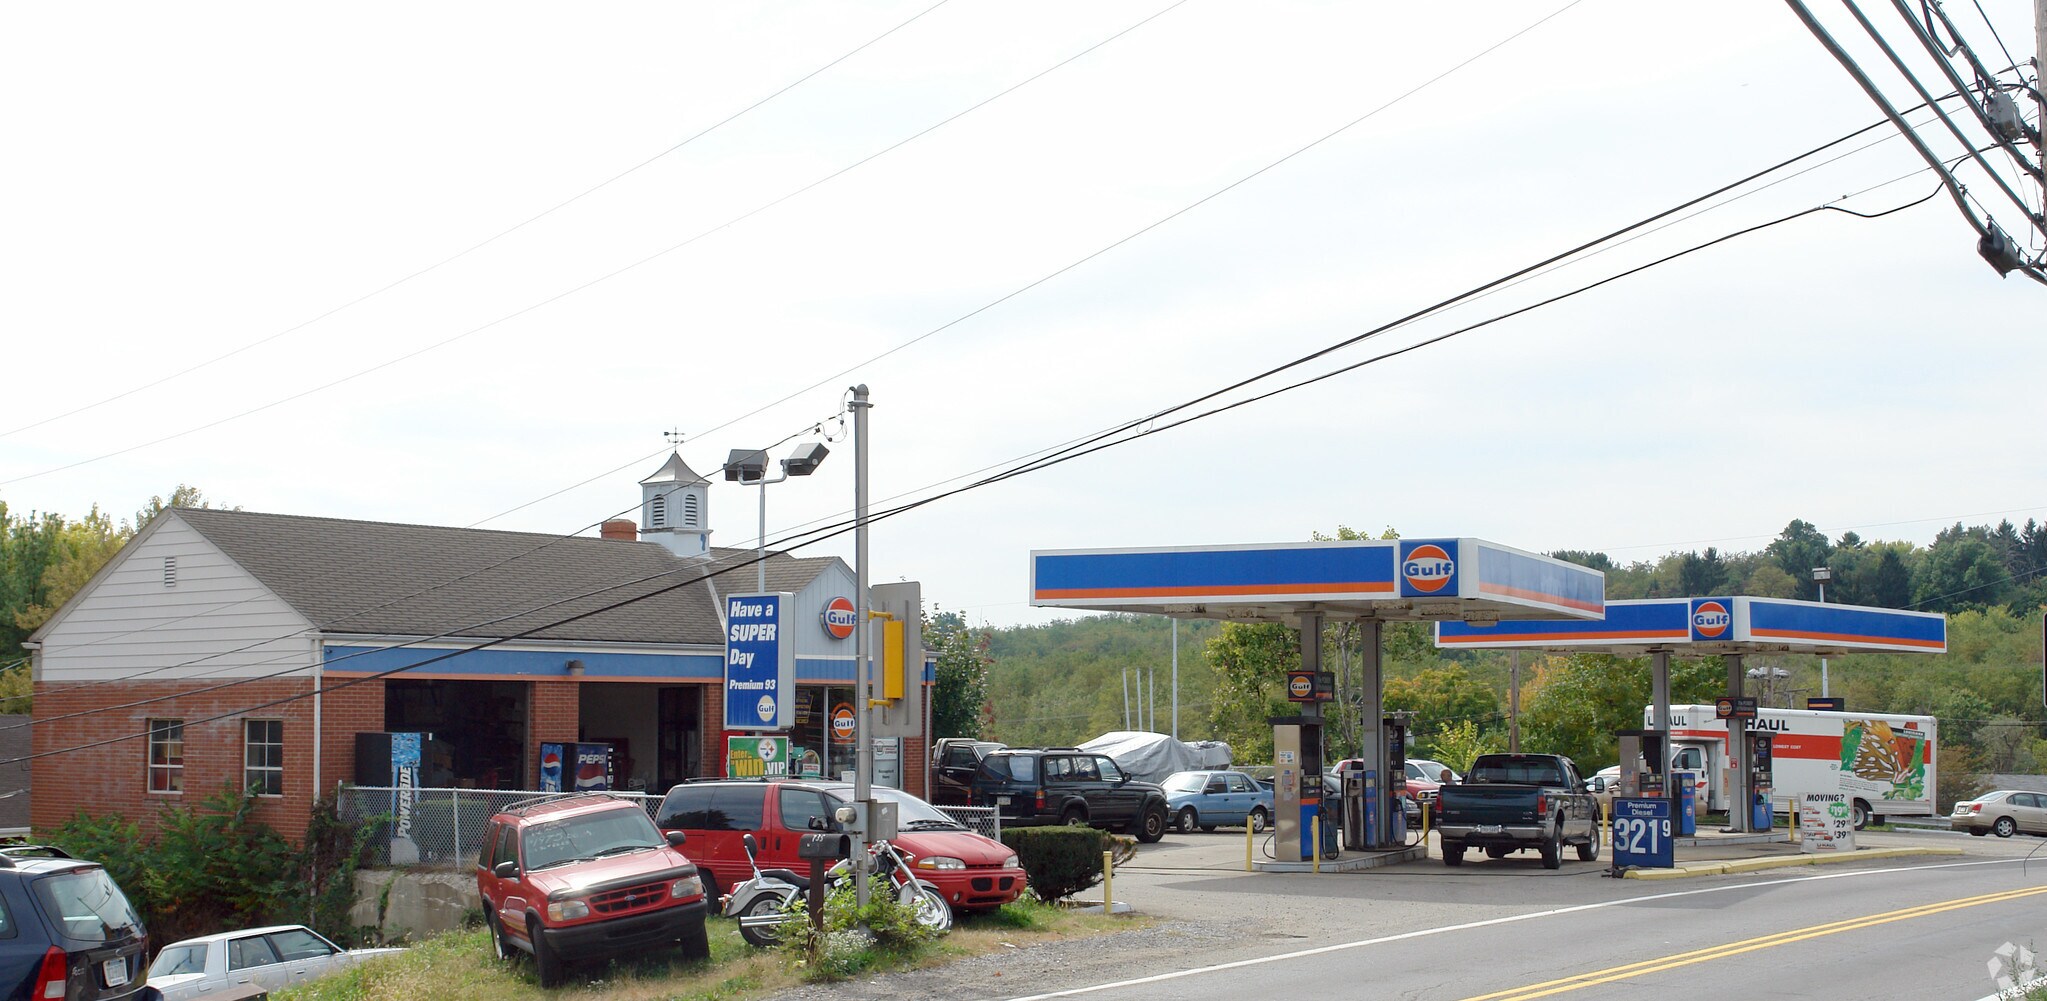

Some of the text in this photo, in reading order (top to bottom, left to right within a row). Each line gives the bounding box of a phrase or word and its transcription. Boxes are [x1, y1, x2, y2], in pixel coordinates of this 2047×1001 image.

[1405, 562, 1452, 576] Gulf
[730, 601, 774, 617] Have a
[828, 611, 856, 625] Gulf
[1694, 615, 1728, 625] Gulf
[730, 624, 777, 642] SUPER
[730, 649, 754, 668] Day
[729, 680, 776, 690] Premium 93
[758, 704, 775, 712] Gulf
[834, 720, 854, 728] Gulf
[578, 754, 606, 764] PEPSI
[730, 749, 748, 759] Enter
[766, 761, 785, 775] VIP
[1806, 794, 1845, 802] MOVING?
